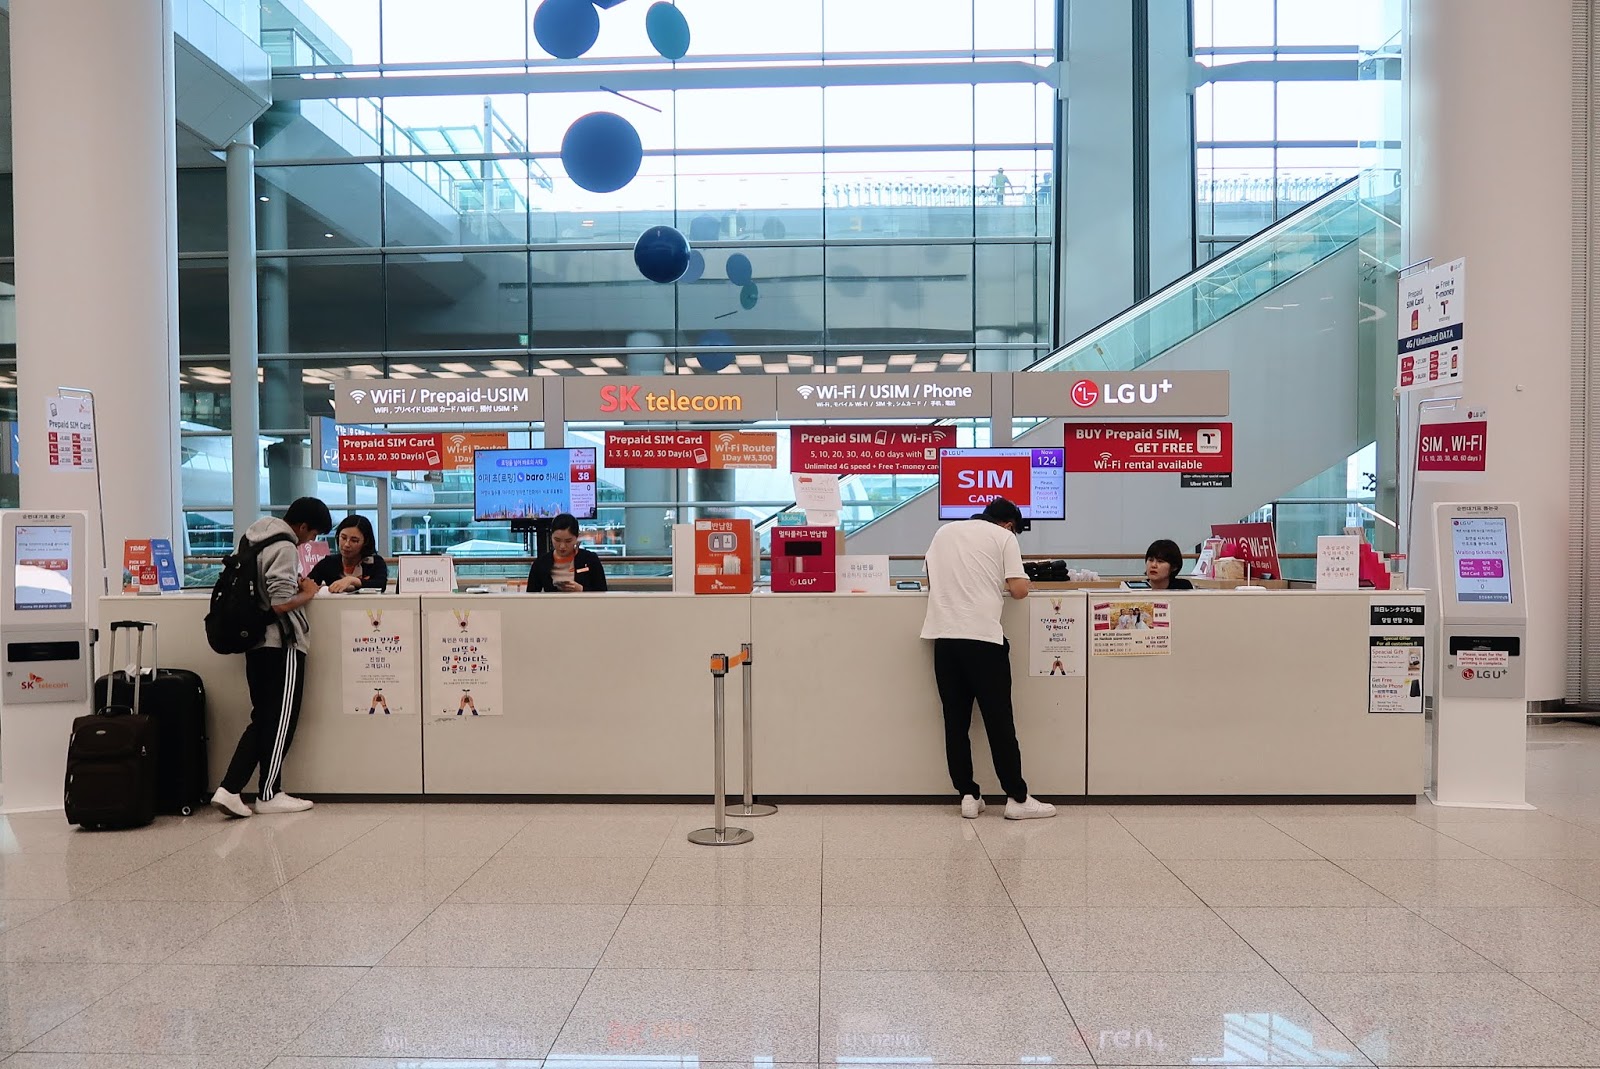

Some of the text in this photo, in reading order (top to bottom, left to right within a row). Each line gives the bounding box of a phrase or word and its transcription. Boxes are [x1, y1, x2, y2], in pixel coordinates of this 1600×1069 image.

[1439, 329, 1454, 340] DATA
[816, 383, 972, 399] Wi-Fi / USIM / Phone
[370, 388, 529, 405] WiFi / Prepaid-USIM
[600, 385, 742, 412] SK telecom
[49, 419, 91, 430] Prepaid SIM Card
[609, 435, 703, 445] Prepaid SIM Card
[801, 433, 846, 445] Prepaid
[849, 433, 872, 443] SIM
[901, 433, 932, 444] Wi-Fi
[1076, 429, 1183, 441] BUY Prepaid SIM,
[343, 437, 435, 449] Prepaid SIM Card
[715, 443, 776, 452] Wi-Fi Router
[1134, 443, 1194, 453] GET FREE
[1421, 435, 1483, 452] SIM WI-FI
[366, 453, 376, 461] 10,
[401, 452, 425, 461] Day(s)
[632, 450, 642, 458] 10,
[644, 450, 655, 458] 20,
[668, 450, 692, 459] Day(s)
[810, 450, 922, 460] 5, 10, 20, 30, 40, 60 days with
[1037, 456, 1057, 466] 124
[1094, 459, 1203, 469] Wi-Fi rental available
[850, 463, 871, 472] speed
[895, 463, 925, 472] T-money
[525, 473, 545, 481] baro
[577, 472, 590, 481] 38
[957, 470, 1013, 489] SIM
[712, 522, 733, 531] 반납함
[779, 530, 828, 538] 멀티플러그 반납함
[21, 681, 69, 690] SK telecom
